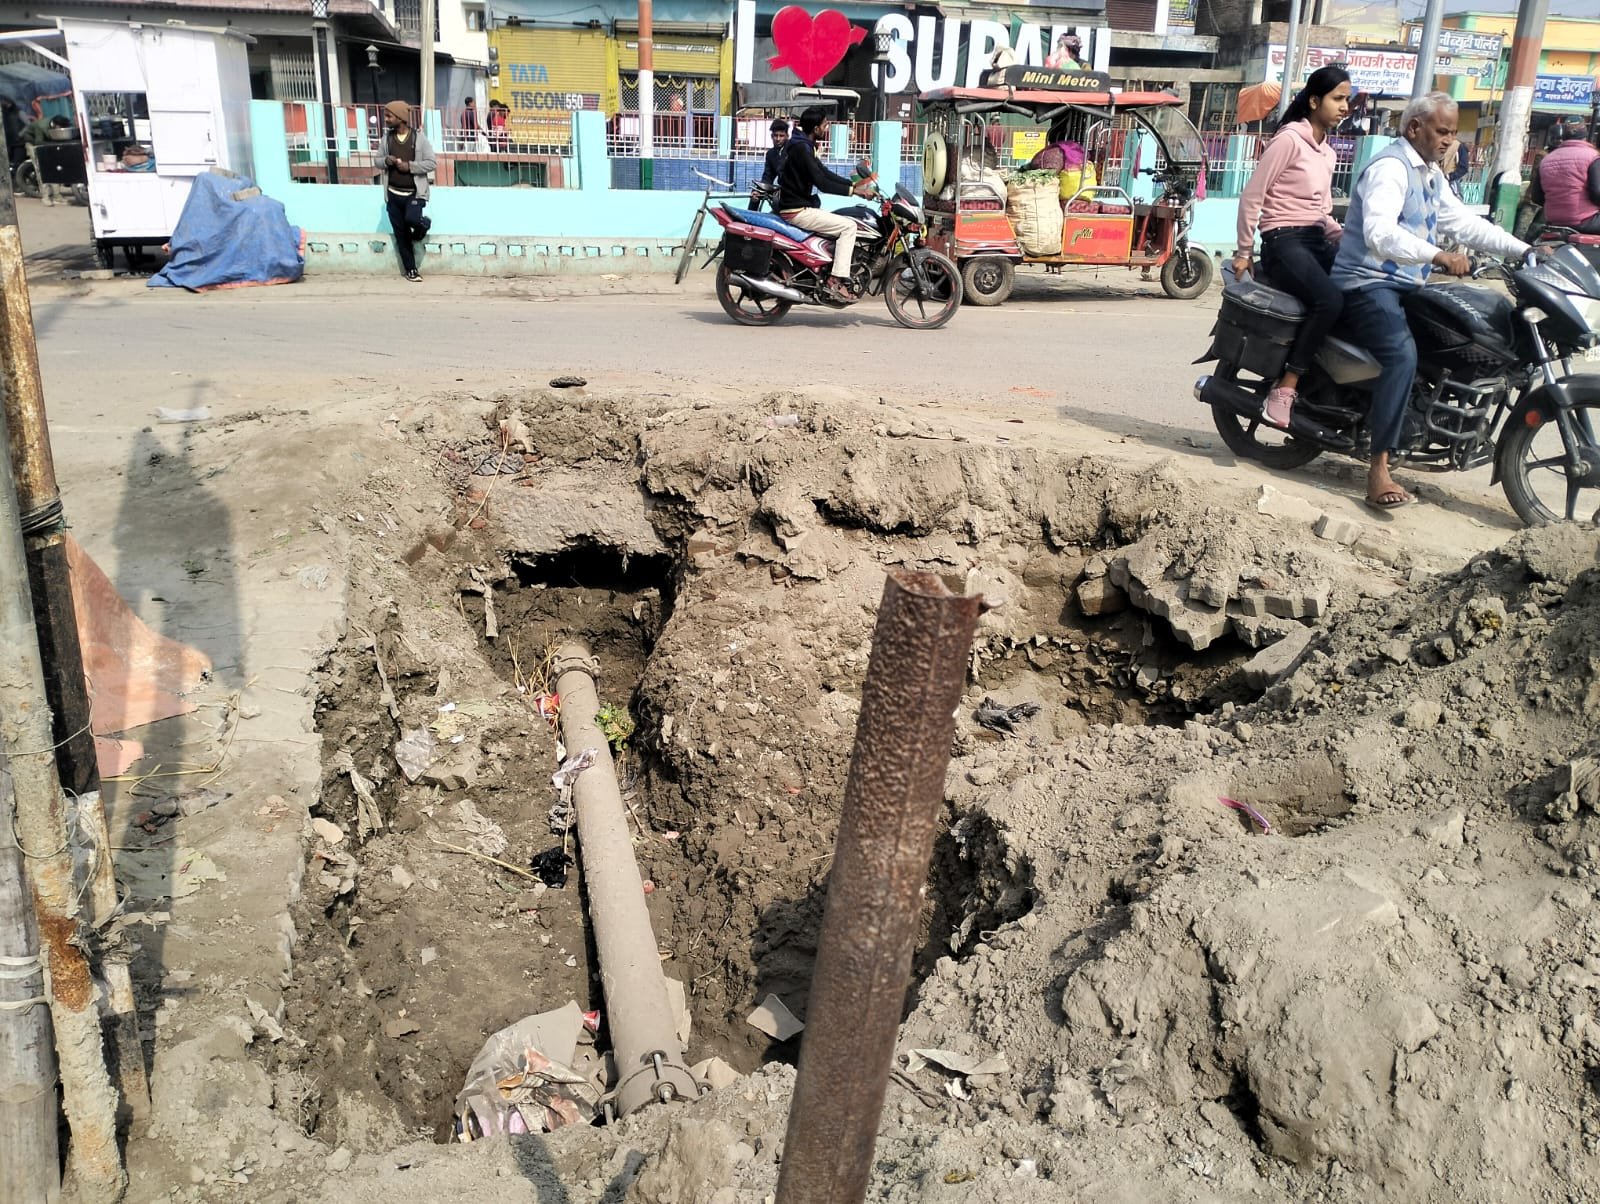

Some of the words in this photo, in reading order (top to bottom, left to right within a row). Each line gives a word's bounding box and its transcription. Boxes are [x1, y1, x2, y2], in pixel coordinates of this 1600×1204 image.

[1348, 53, 1385, 69] गायत्री
[1385, 55, 1417, 71] स्टोर्स
[509, 64, 548, 83] TATA
[1022, 70, 1054, 85] Mini
[1057, 74, 1101, 88] Metro
[1556, 77, 1593, 97] सैलून
[510, 91, 564, 111] TISCON
